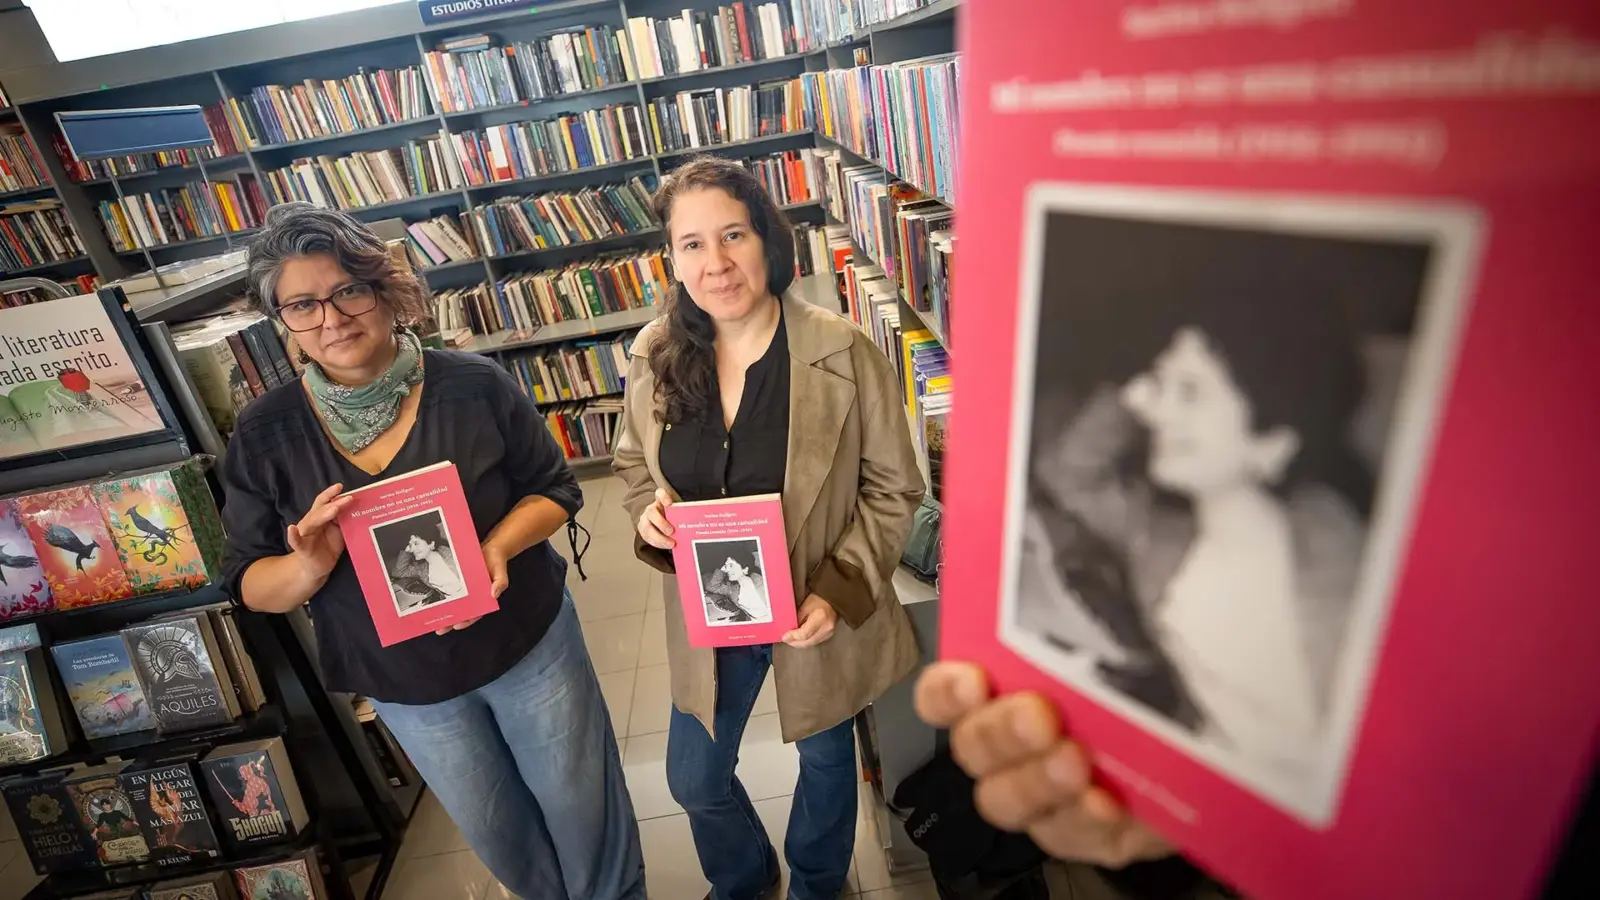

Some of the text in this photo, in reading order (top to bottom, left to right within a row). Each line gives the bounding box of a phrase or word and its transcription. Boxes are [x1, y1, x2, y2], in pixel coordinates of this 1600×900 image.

[431, 0, 482, 16] ESTUDIOS
[1, 327, 105, 358] literatura
[0, 351, 118, 386] ada escrito.
[48, 395, 138, 416] Monterroso
[87, 656, 120, 668] Bombadil
[160, 694, 217, 715] AQUILES
[131, 767, 188, 785] EN ALGÚN
[153, 779, 192, 792] LUGAR
[178, 789, 196, 799] DEL
[165, 799, 201, 812] MAR
[149, 812, 205, 828] MÁS AZUL
[32, 832, 72, 848] HIELO
[38, 843, 85, 858] ESTRELLAS
[158, 855, 192, 866] TJ KLUNE
